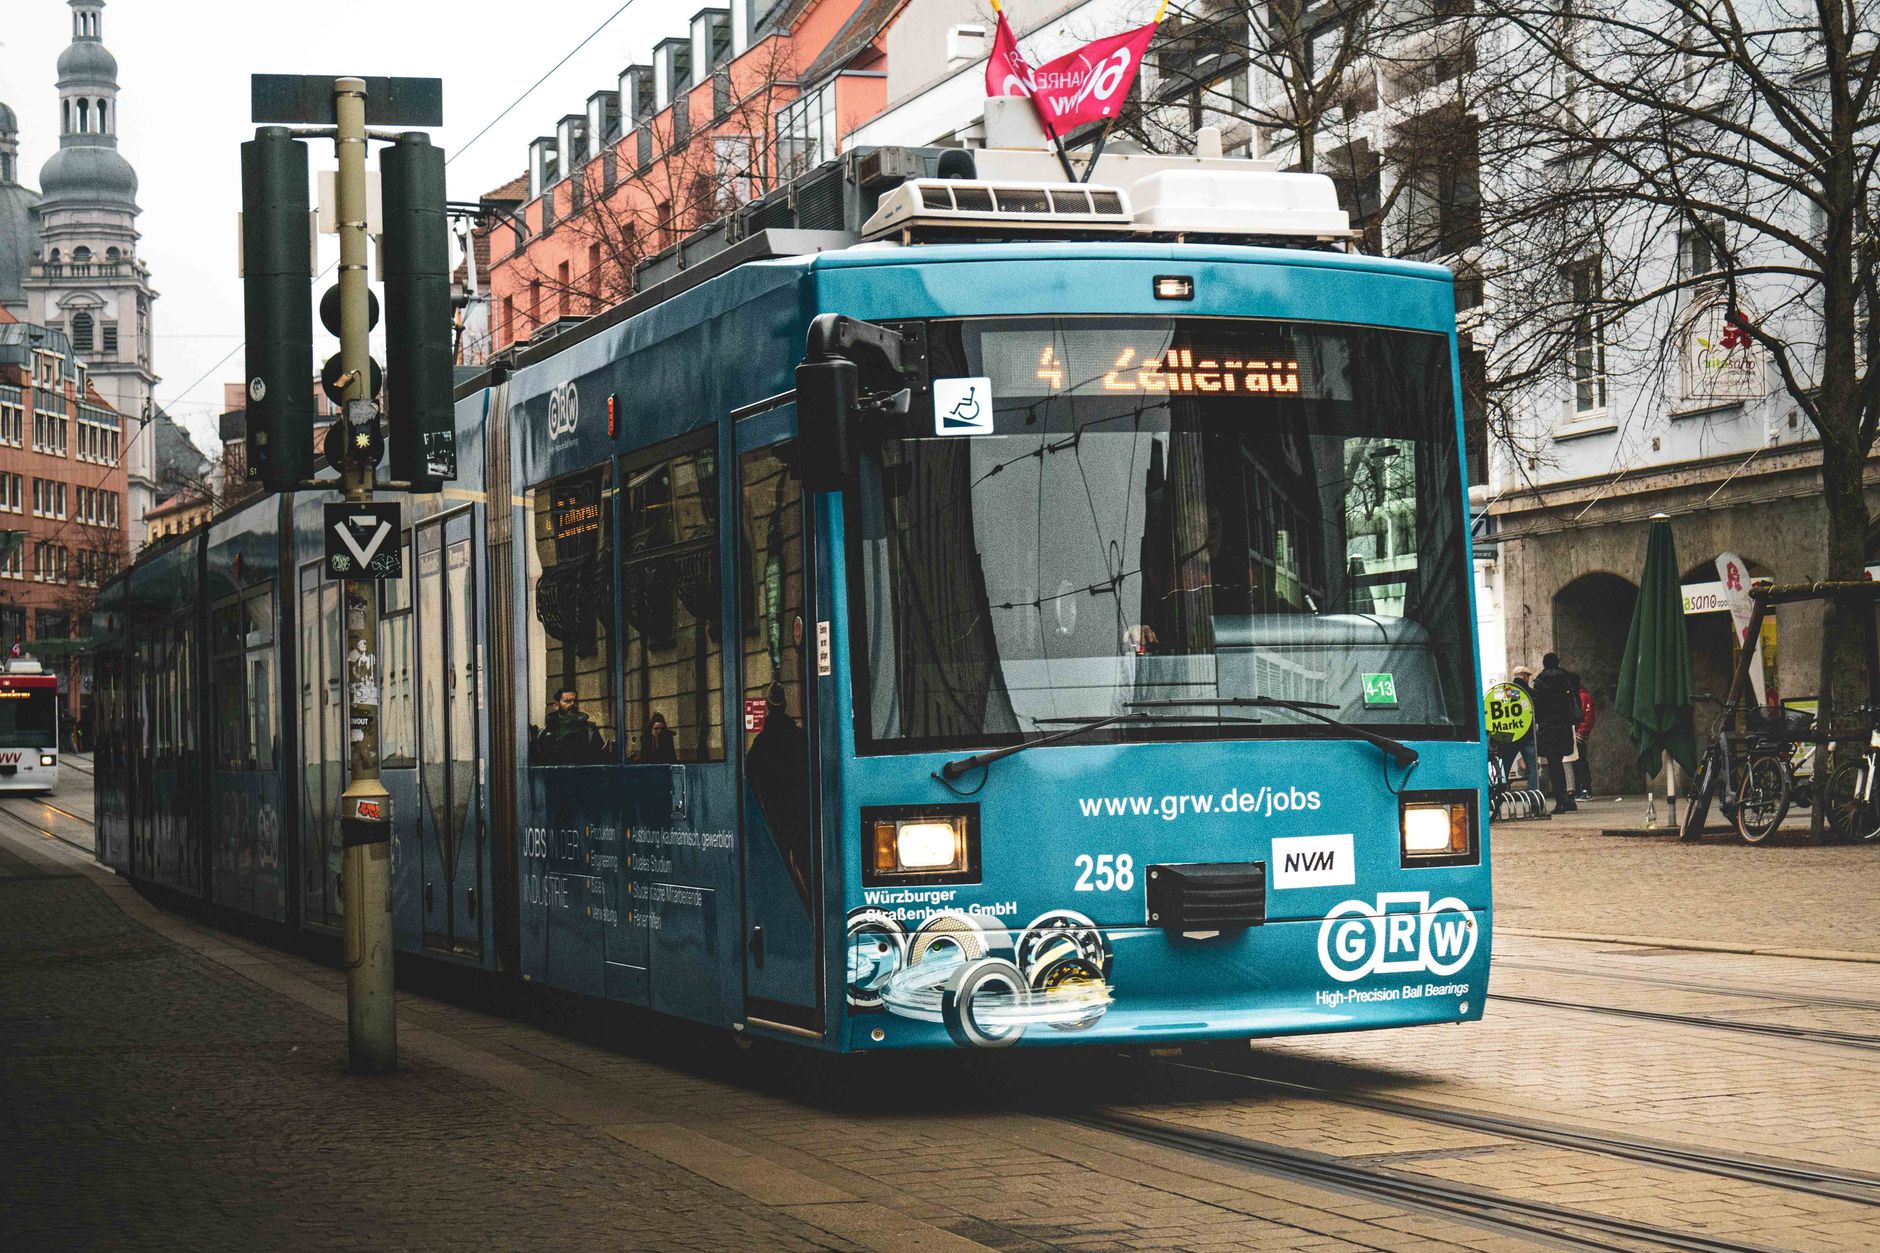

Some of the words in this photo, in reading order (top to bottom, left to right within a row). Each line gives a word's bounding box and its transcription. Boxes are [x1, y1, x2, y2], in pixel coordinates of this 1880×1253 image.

[1037, 346, 1061, 389] 4
[1102, 348, 1298, 392] Zellerau
[1366, 681, 1393, 696] 4-13
[1490, 700, 1523, 720] Bio
[1492, 719, 1524, 732] Markt
[1079, 786, 1322, 820] www.grw.de/jobs
[523, 827, 547, 858] JOBS
[560, 829, 580, 860] DER
[1074, 853, 1135, 892] 258
[1284, 850, 1335, 873] NVM
[524, 874, 569, 909] INDUSTRIE
[864, 888, 957, 905] Würzburger
[866, 906, 965, 922] Straßenbahn
[969, 901, 1018, 917] GmbH
[1316, 987, 1400, 1007] High-Precision
[1402, 984, 1423, 1000] Ball
[1424, 982, 1470, 999] Bearings
